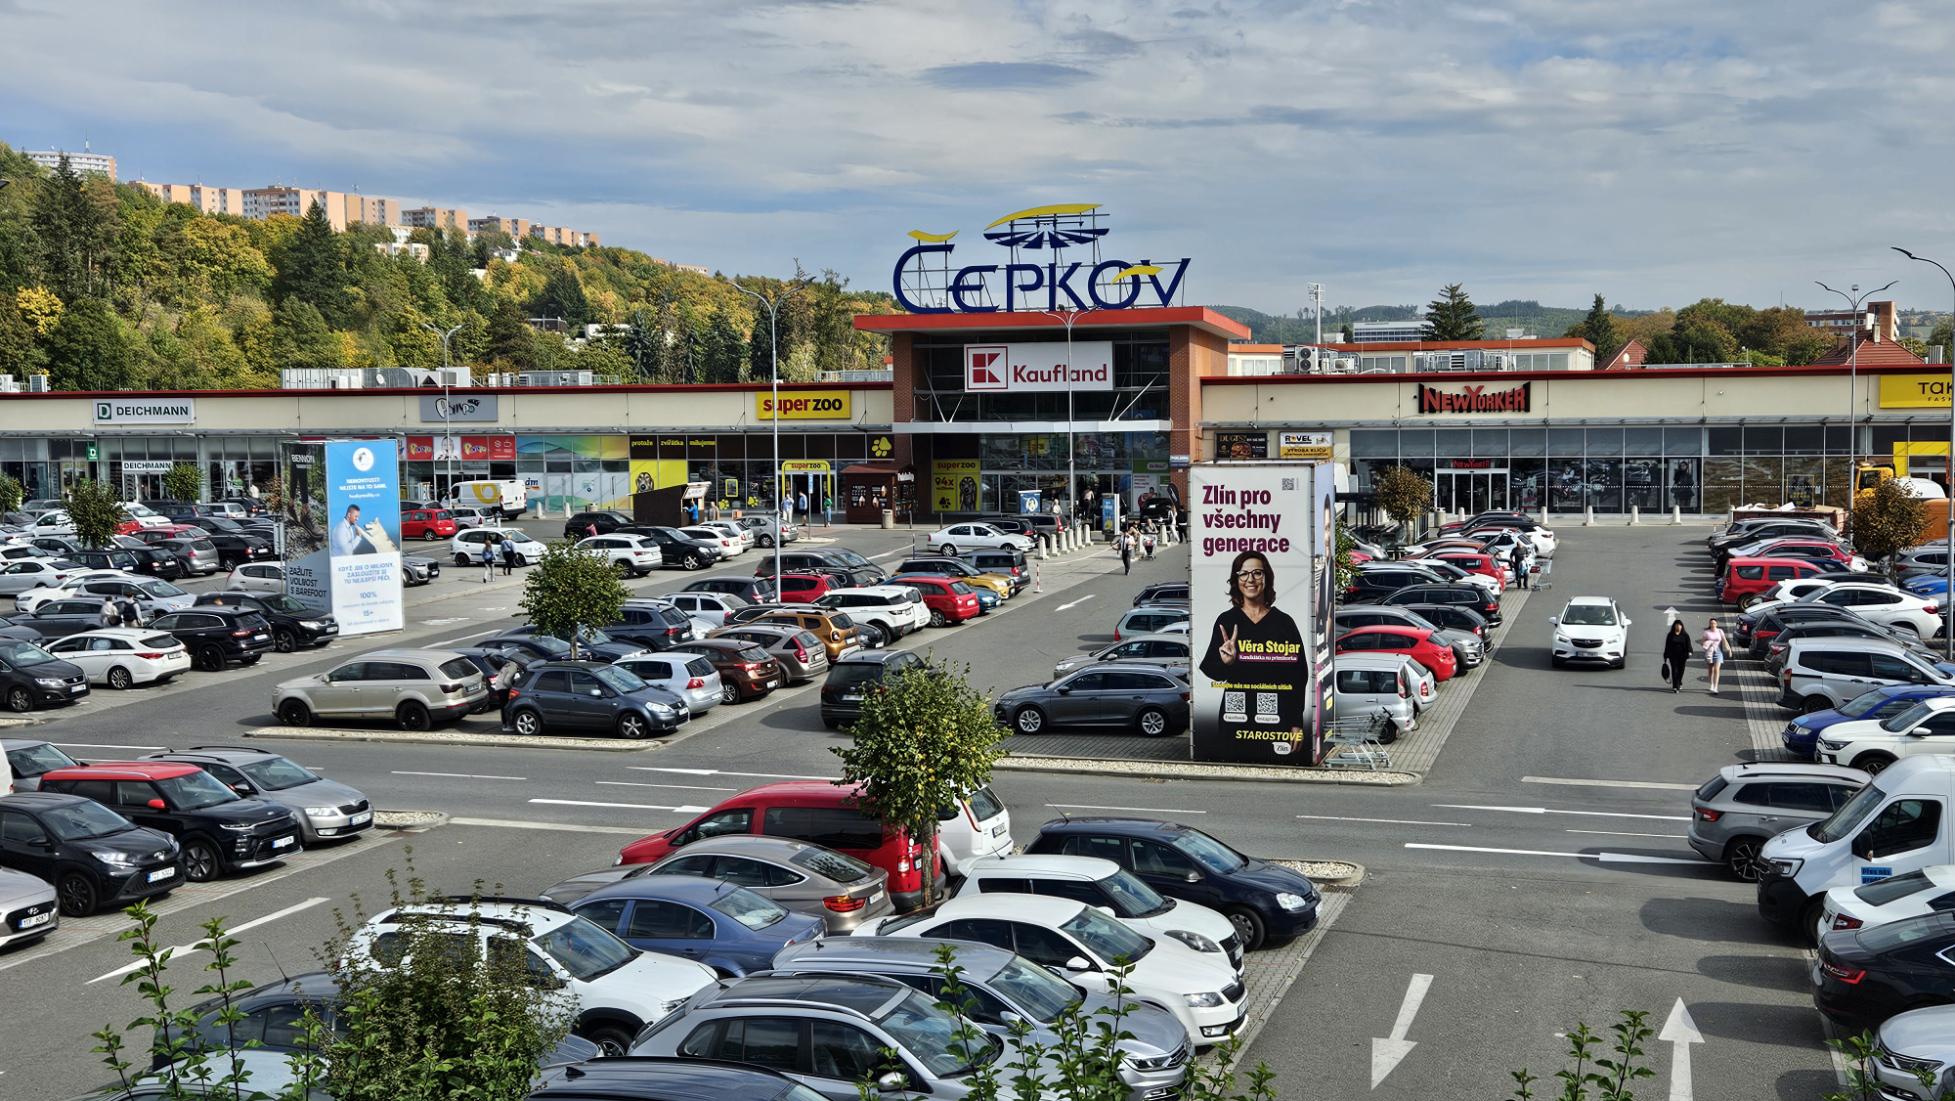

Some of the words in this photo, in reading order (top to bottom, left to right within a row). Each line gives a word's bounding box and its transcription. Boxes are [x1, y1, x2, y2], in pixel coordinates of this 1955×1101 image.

[893, 229, 1191, 313] ČEPKOV
[1013, 364, 1107, 383] Kaufland
[116, 406, 188, 416] DEICHMANN
[123, 462, 172, 470] DEICHMANN
[1202, 484, 1236, 505] Zlín
[1240, 489, 1272, 509] pro
[1203, 508, 1281, 533] všechny
[1203, 537, 1290, 556] generace
[290, 578, 318, 588] VOLNOST
[296, 588, 328, 598] BAREFOOT
[1238, 639, 1264, 653] Věra
[1265, 641, 1301, 656] Stojar
[1235, 729, 1304, 742] STAROSTOVÉ
